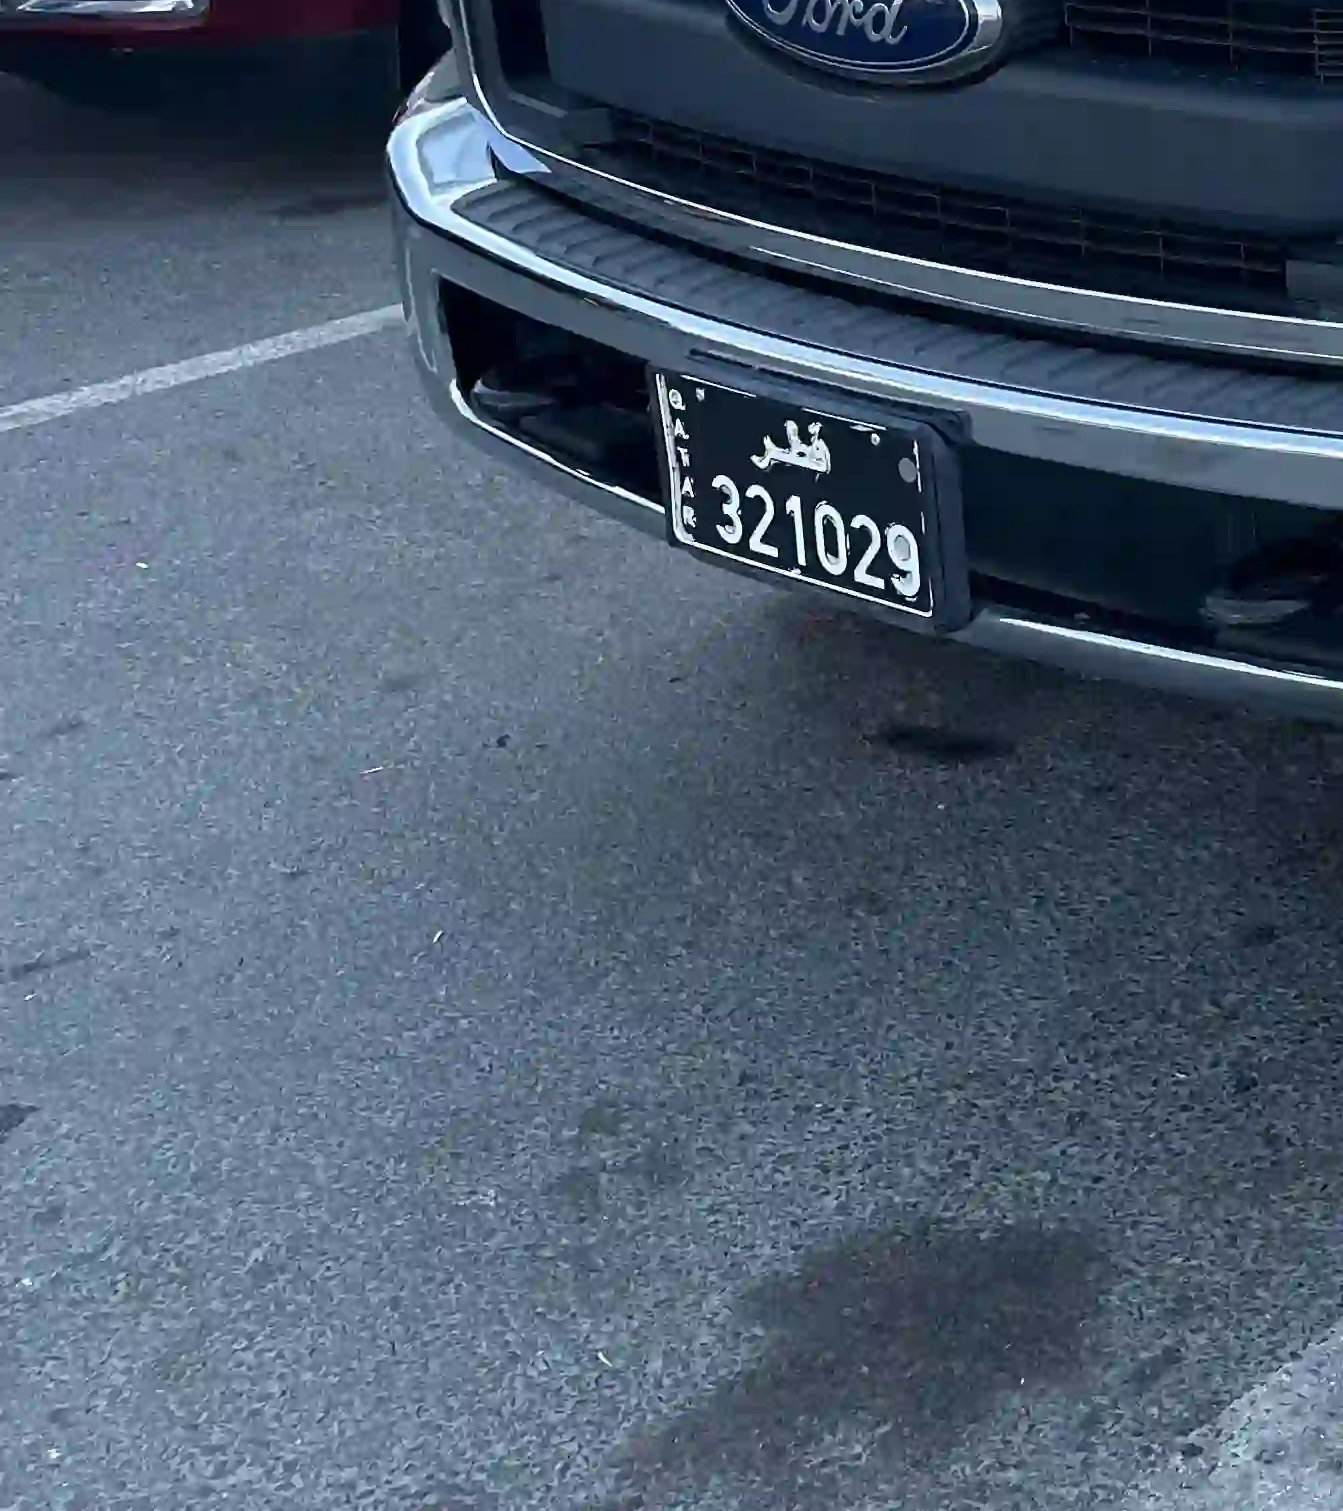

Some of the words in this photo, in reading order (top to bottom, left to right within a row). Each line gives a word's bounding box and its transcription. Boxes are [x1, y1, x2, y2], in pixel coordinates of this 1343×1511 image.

[668, 388, 697, 528] QATAR
[750, 419, 832, 481] قطر
[711, 474, 922, 599] 321029
